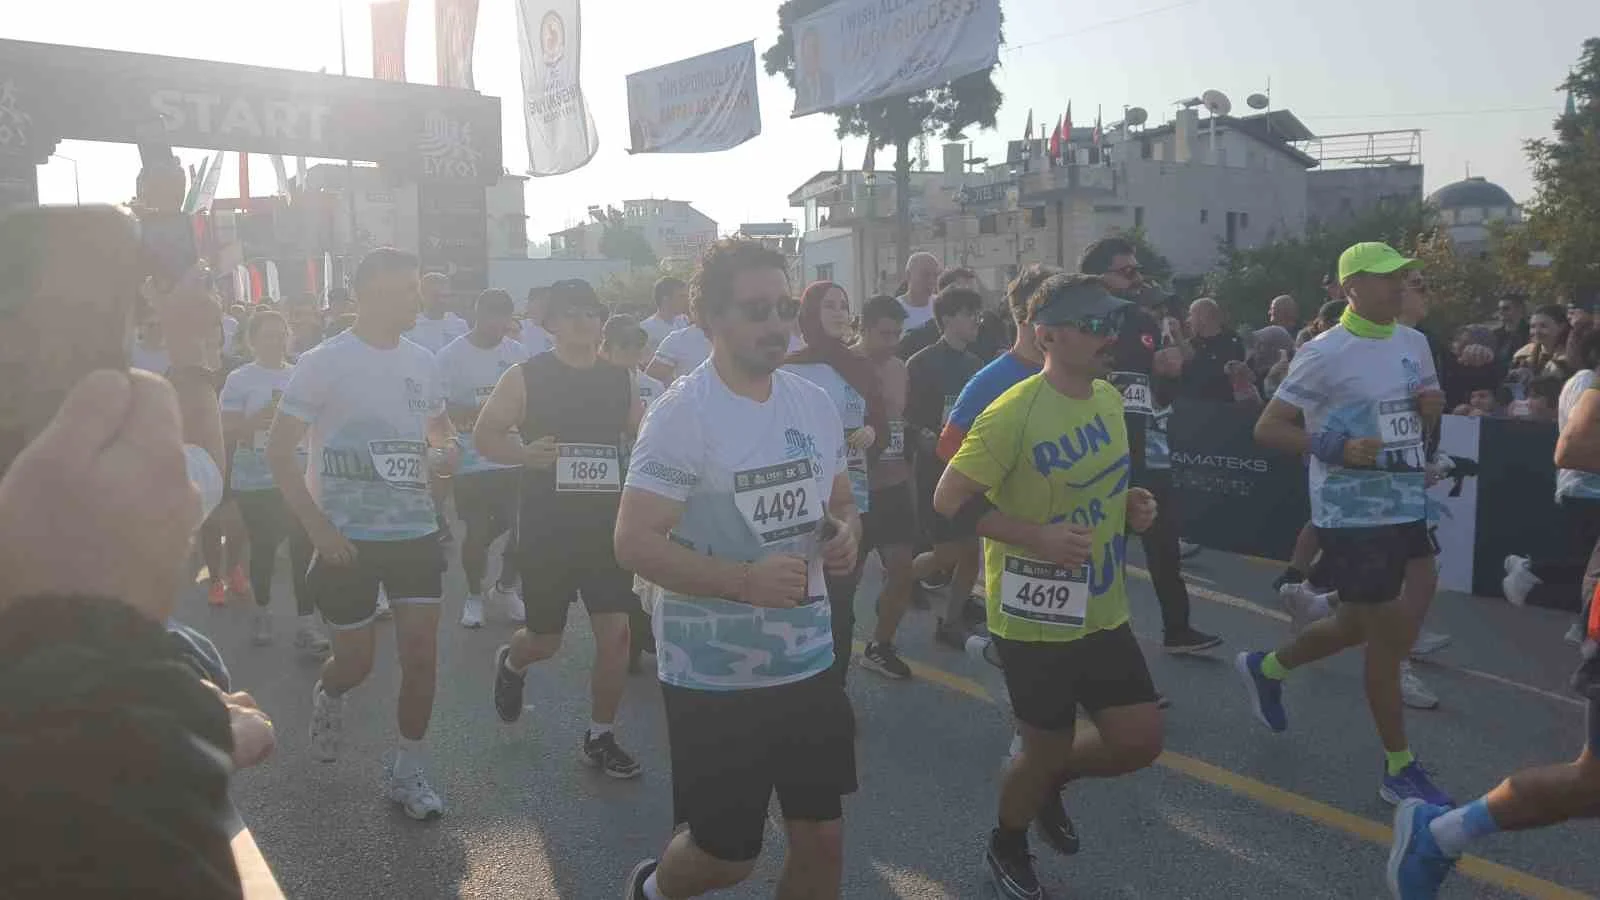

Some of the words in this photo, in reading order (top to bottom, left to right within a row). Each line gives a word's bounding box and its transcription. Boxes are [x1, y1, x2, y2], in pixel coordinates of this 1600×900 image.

[150, 88, 330, 141] START
[1032, 412, 1112, 477] RUN
[568, 461, 608, 480] 1869
[752, 487, 809, 525] 4492
[1015, 582, 1070, 609] 4619
